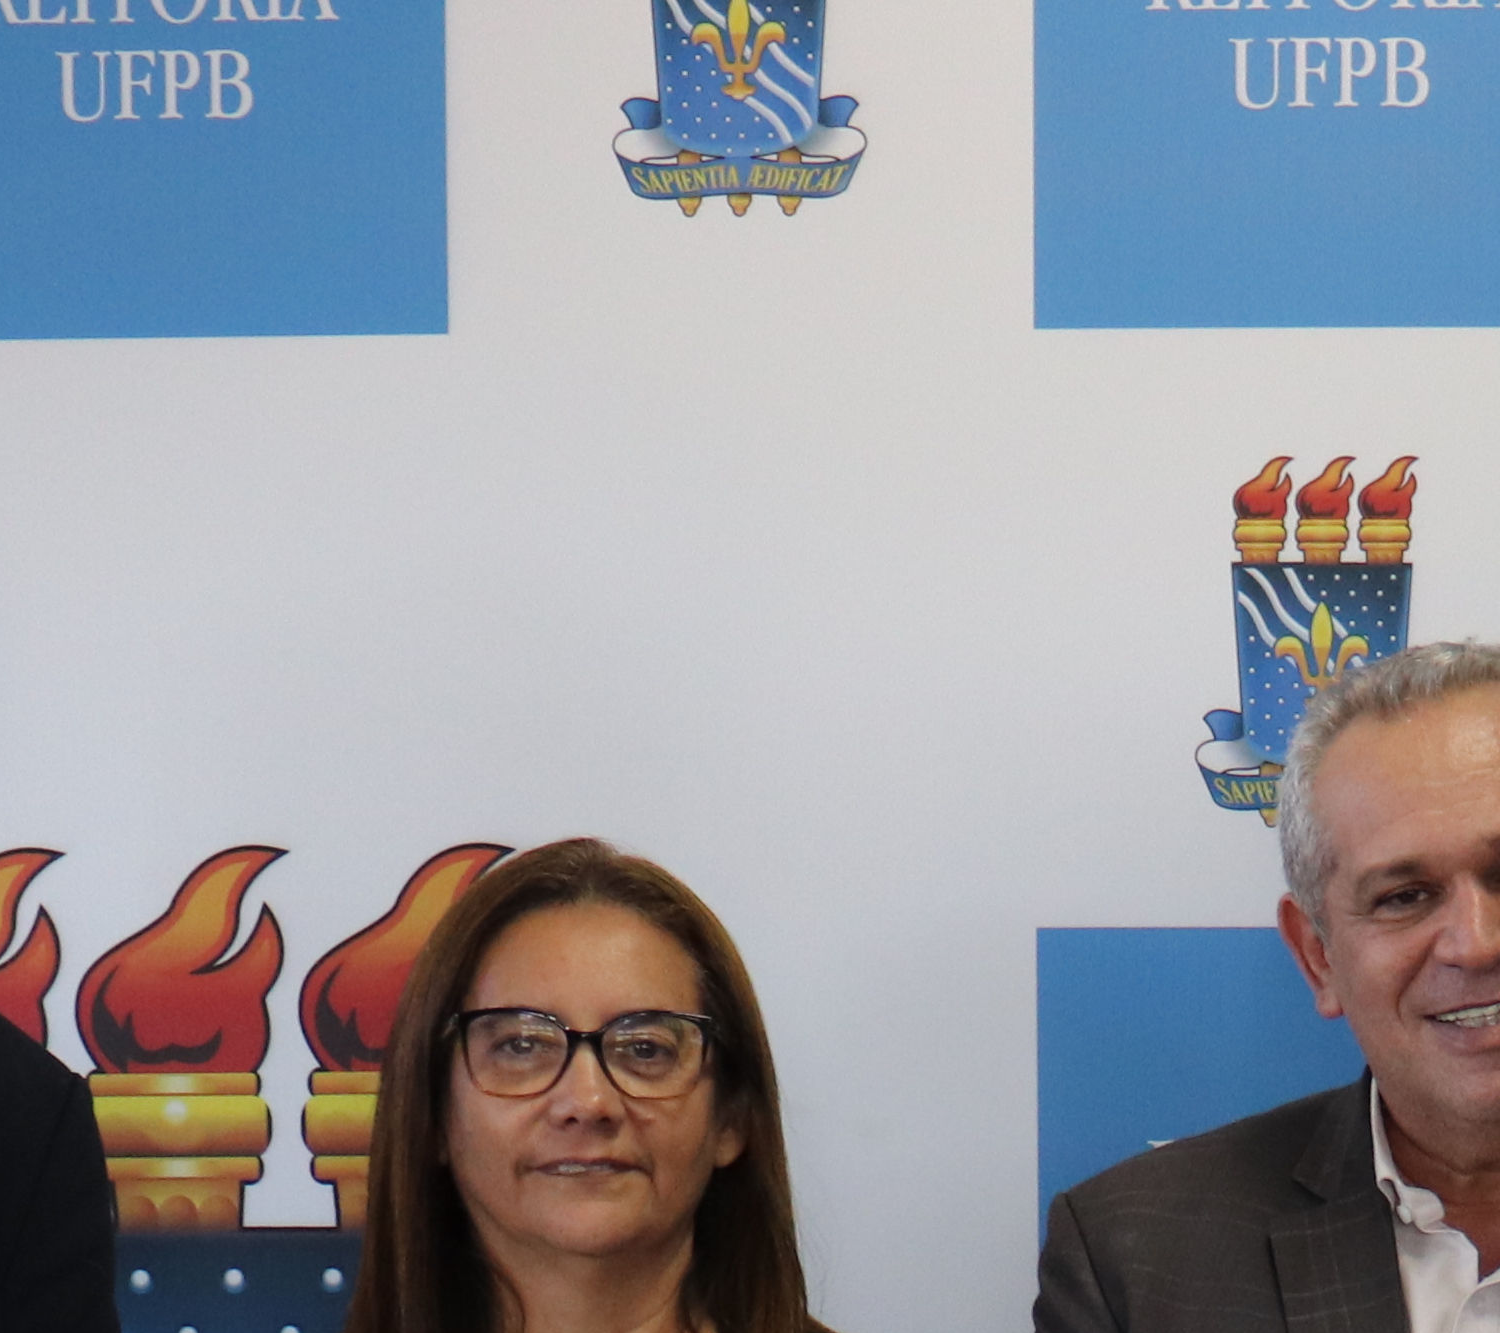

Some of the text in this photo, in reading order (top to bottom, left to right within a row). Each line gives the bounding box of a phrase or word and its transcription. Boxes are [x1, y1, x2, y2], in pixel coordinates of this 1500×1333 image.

[55, 49, 255, 123] UFPB
[1228, 36, 1431, 110] UFPB
[631, 165, 740, 194] SAPIENTIA
